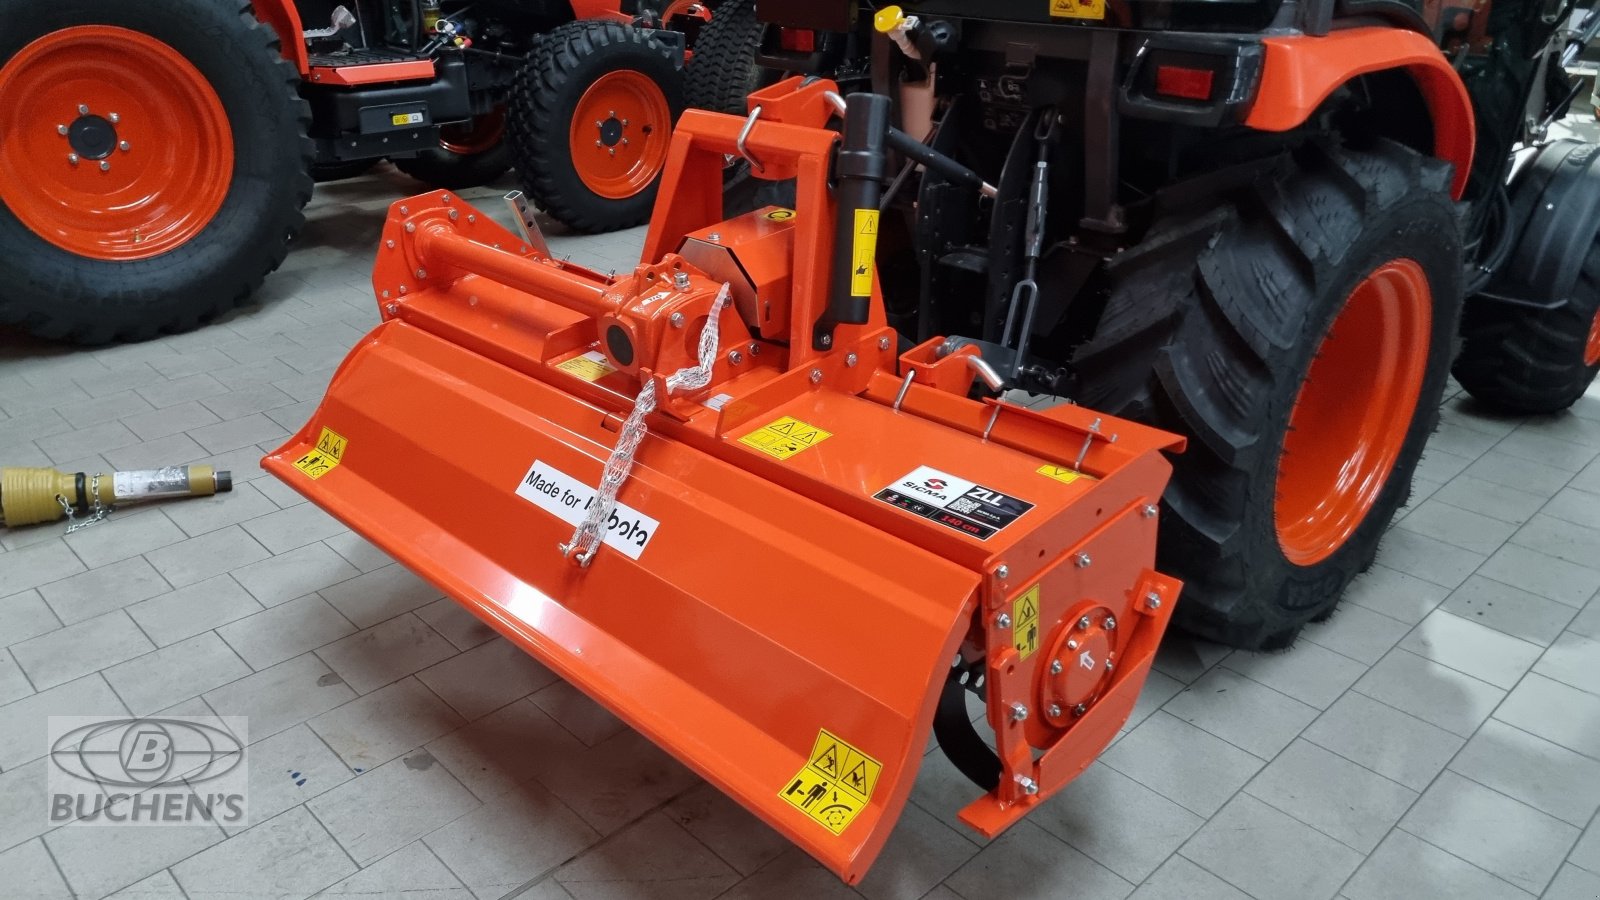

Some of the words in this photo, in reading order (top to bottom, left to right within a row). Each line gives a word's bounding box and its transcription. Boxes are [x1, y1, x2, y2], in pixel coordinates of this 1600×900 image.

[902, 481, 948, 501] SICMA
[966, 487, 1004, 507] ZLL
[525, 470, 560, 498] Made
[560, 489, 582, 509] for
[583, 496, 648, 547] bota
[940, 514, 962, 527] 140
[962, 521, 981, 534] cm
